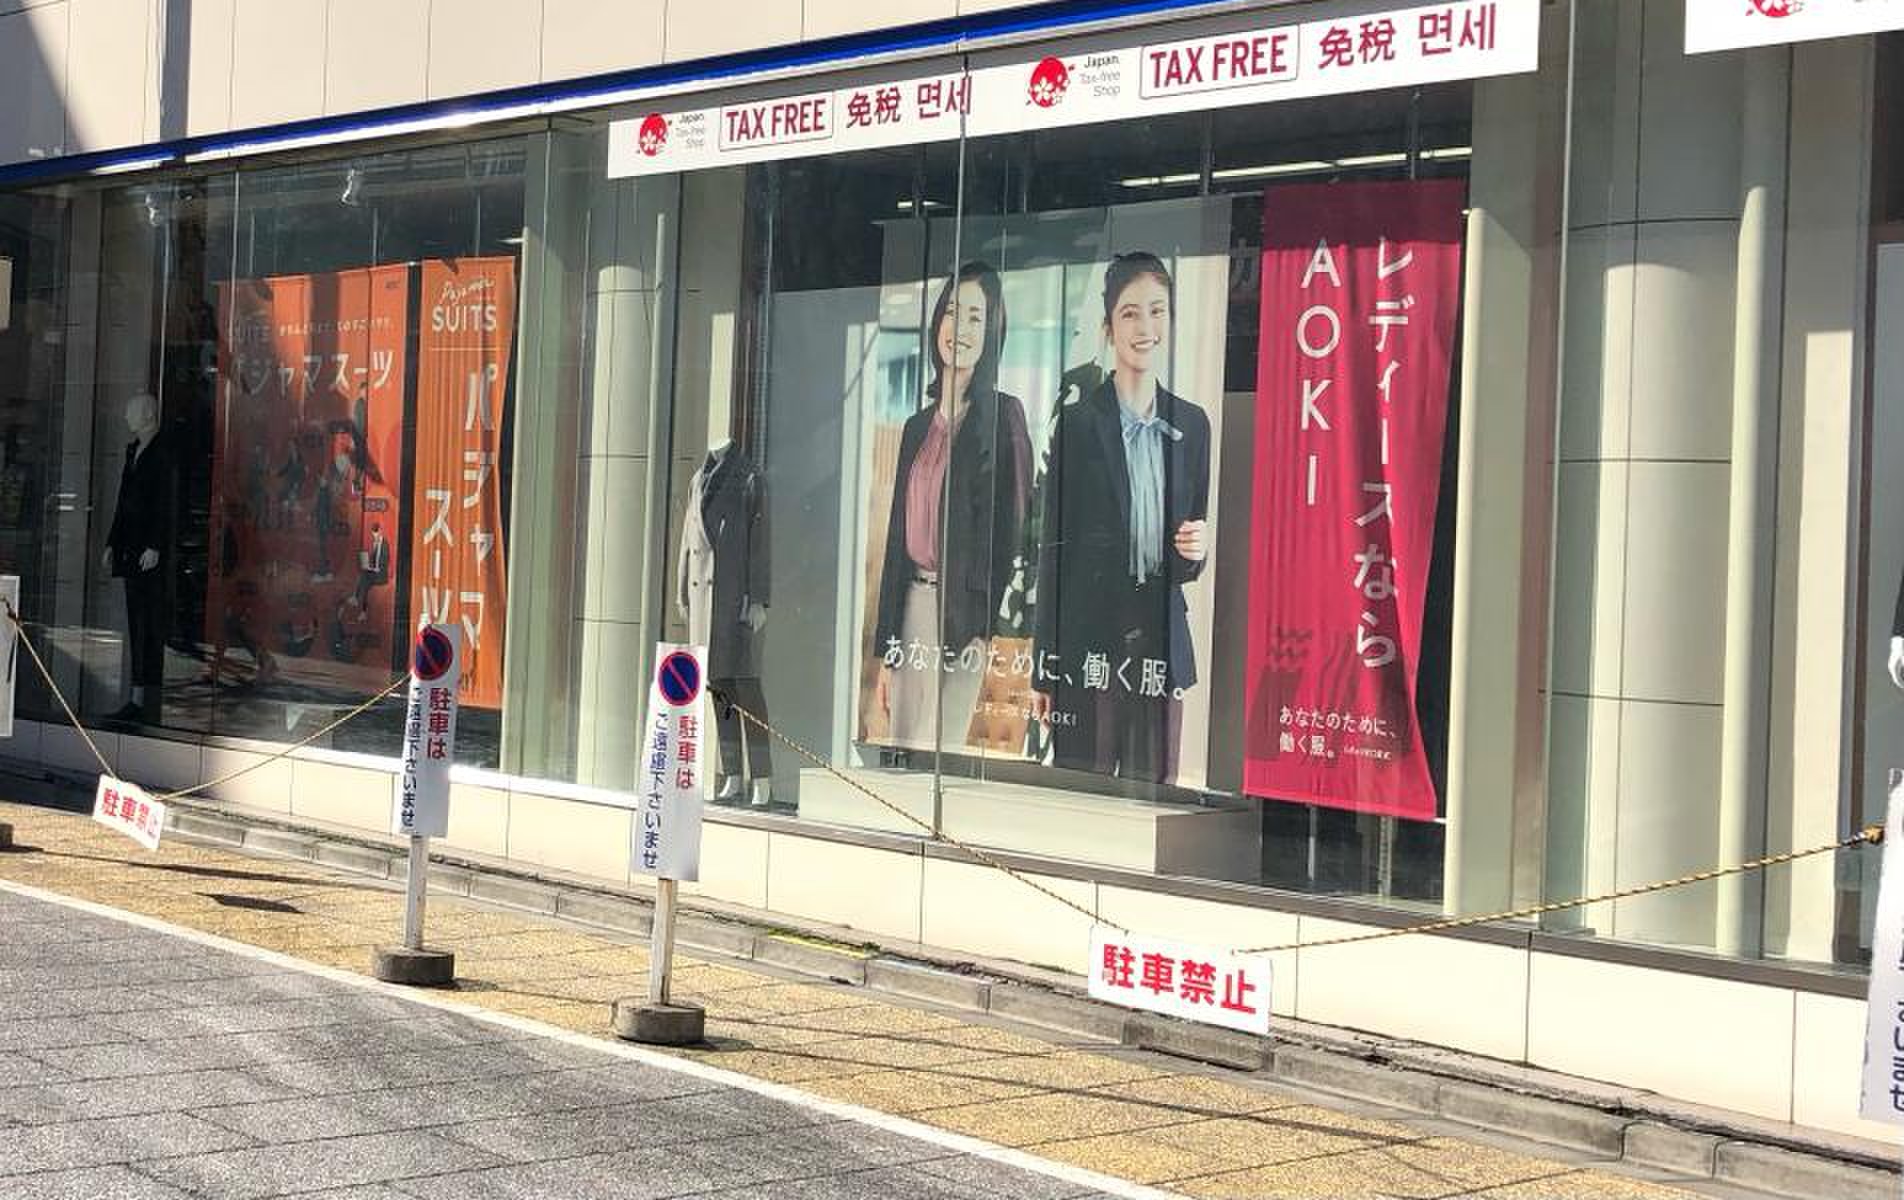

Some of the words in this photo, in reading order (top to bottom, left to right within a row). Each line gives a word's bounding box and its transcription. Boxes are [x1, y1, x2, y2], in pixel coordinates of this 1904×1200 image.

[1419, 2, 1497, 57] 면세
[1150, 46, 1203, 88] TAX
[1212, 34, 1288, 80] FREE
[726, 108, 765, 143] TAX
[771, 99, 826, 137] FREE
[917, 77, 972, 119] 면세
[432, 304, 497, 333] SUITS
[1297, 240, 1341, 506] AOKI
[1353, 237, 1415, 668] レディースなら
[428, 687, 451, 760] 駐車は
[1102, 943, 1257, 1015] 駐車禁止
